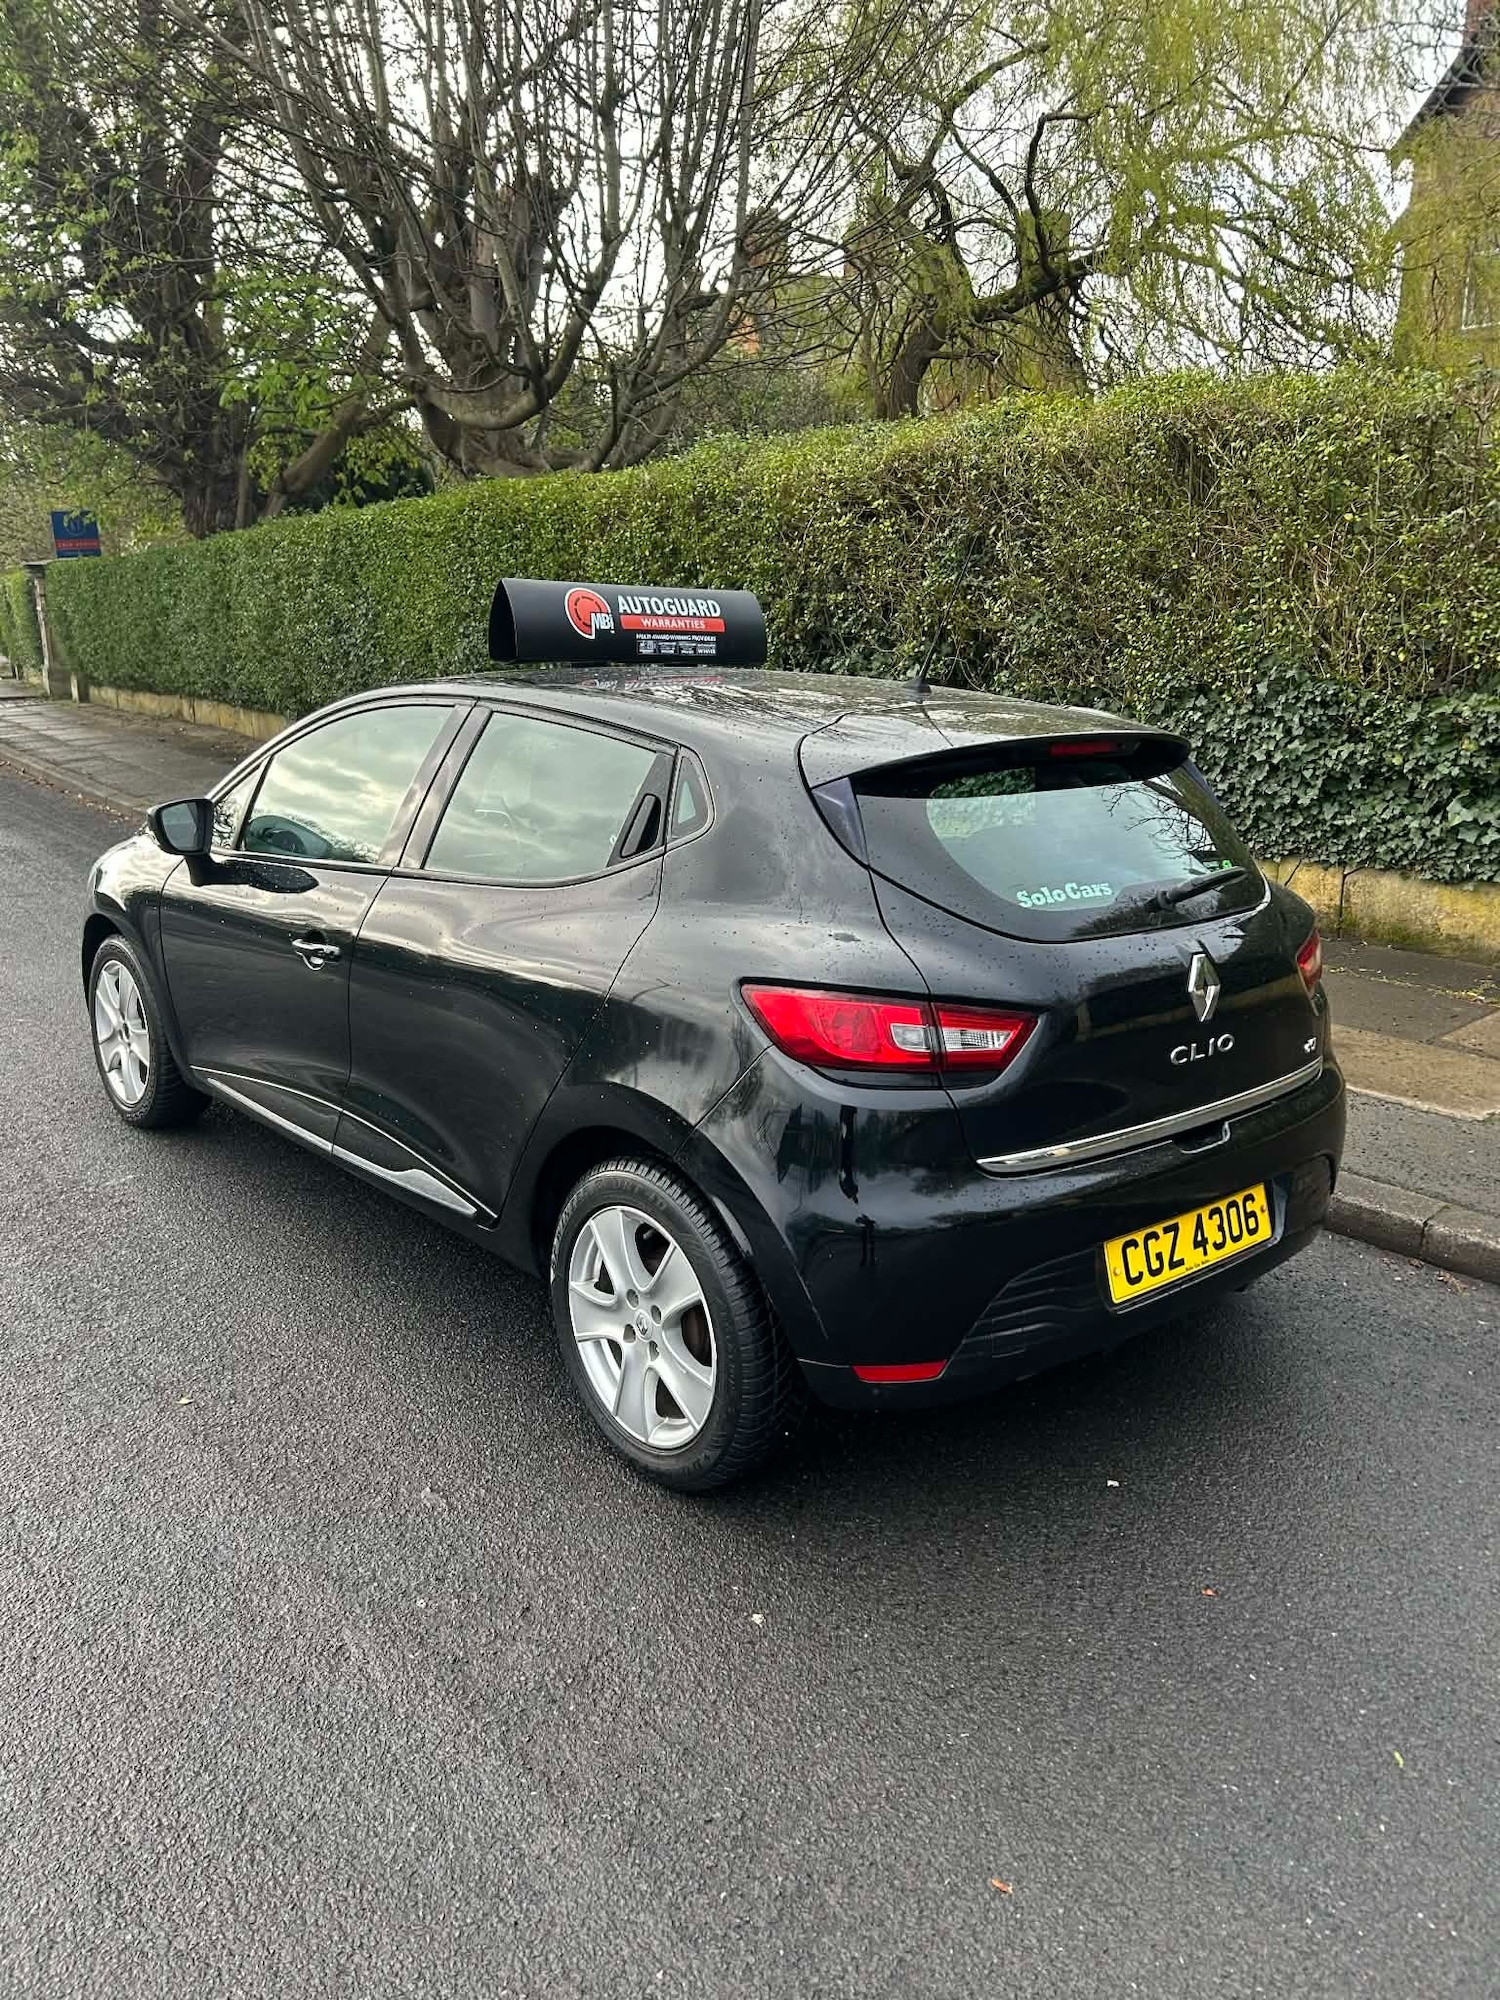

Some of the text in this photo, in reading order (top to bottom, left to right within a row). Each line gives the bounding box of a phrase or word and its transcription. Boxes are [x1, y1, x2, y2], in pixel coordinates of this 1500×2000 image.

[618, 595, 721, 617] AUTOGUARD
[640, 618, 705, 630] WARRANTIES
[1170, 1033, 1236, 1065] CLIO
[1120, 1193, 1259, 1286] CGZ 4306
